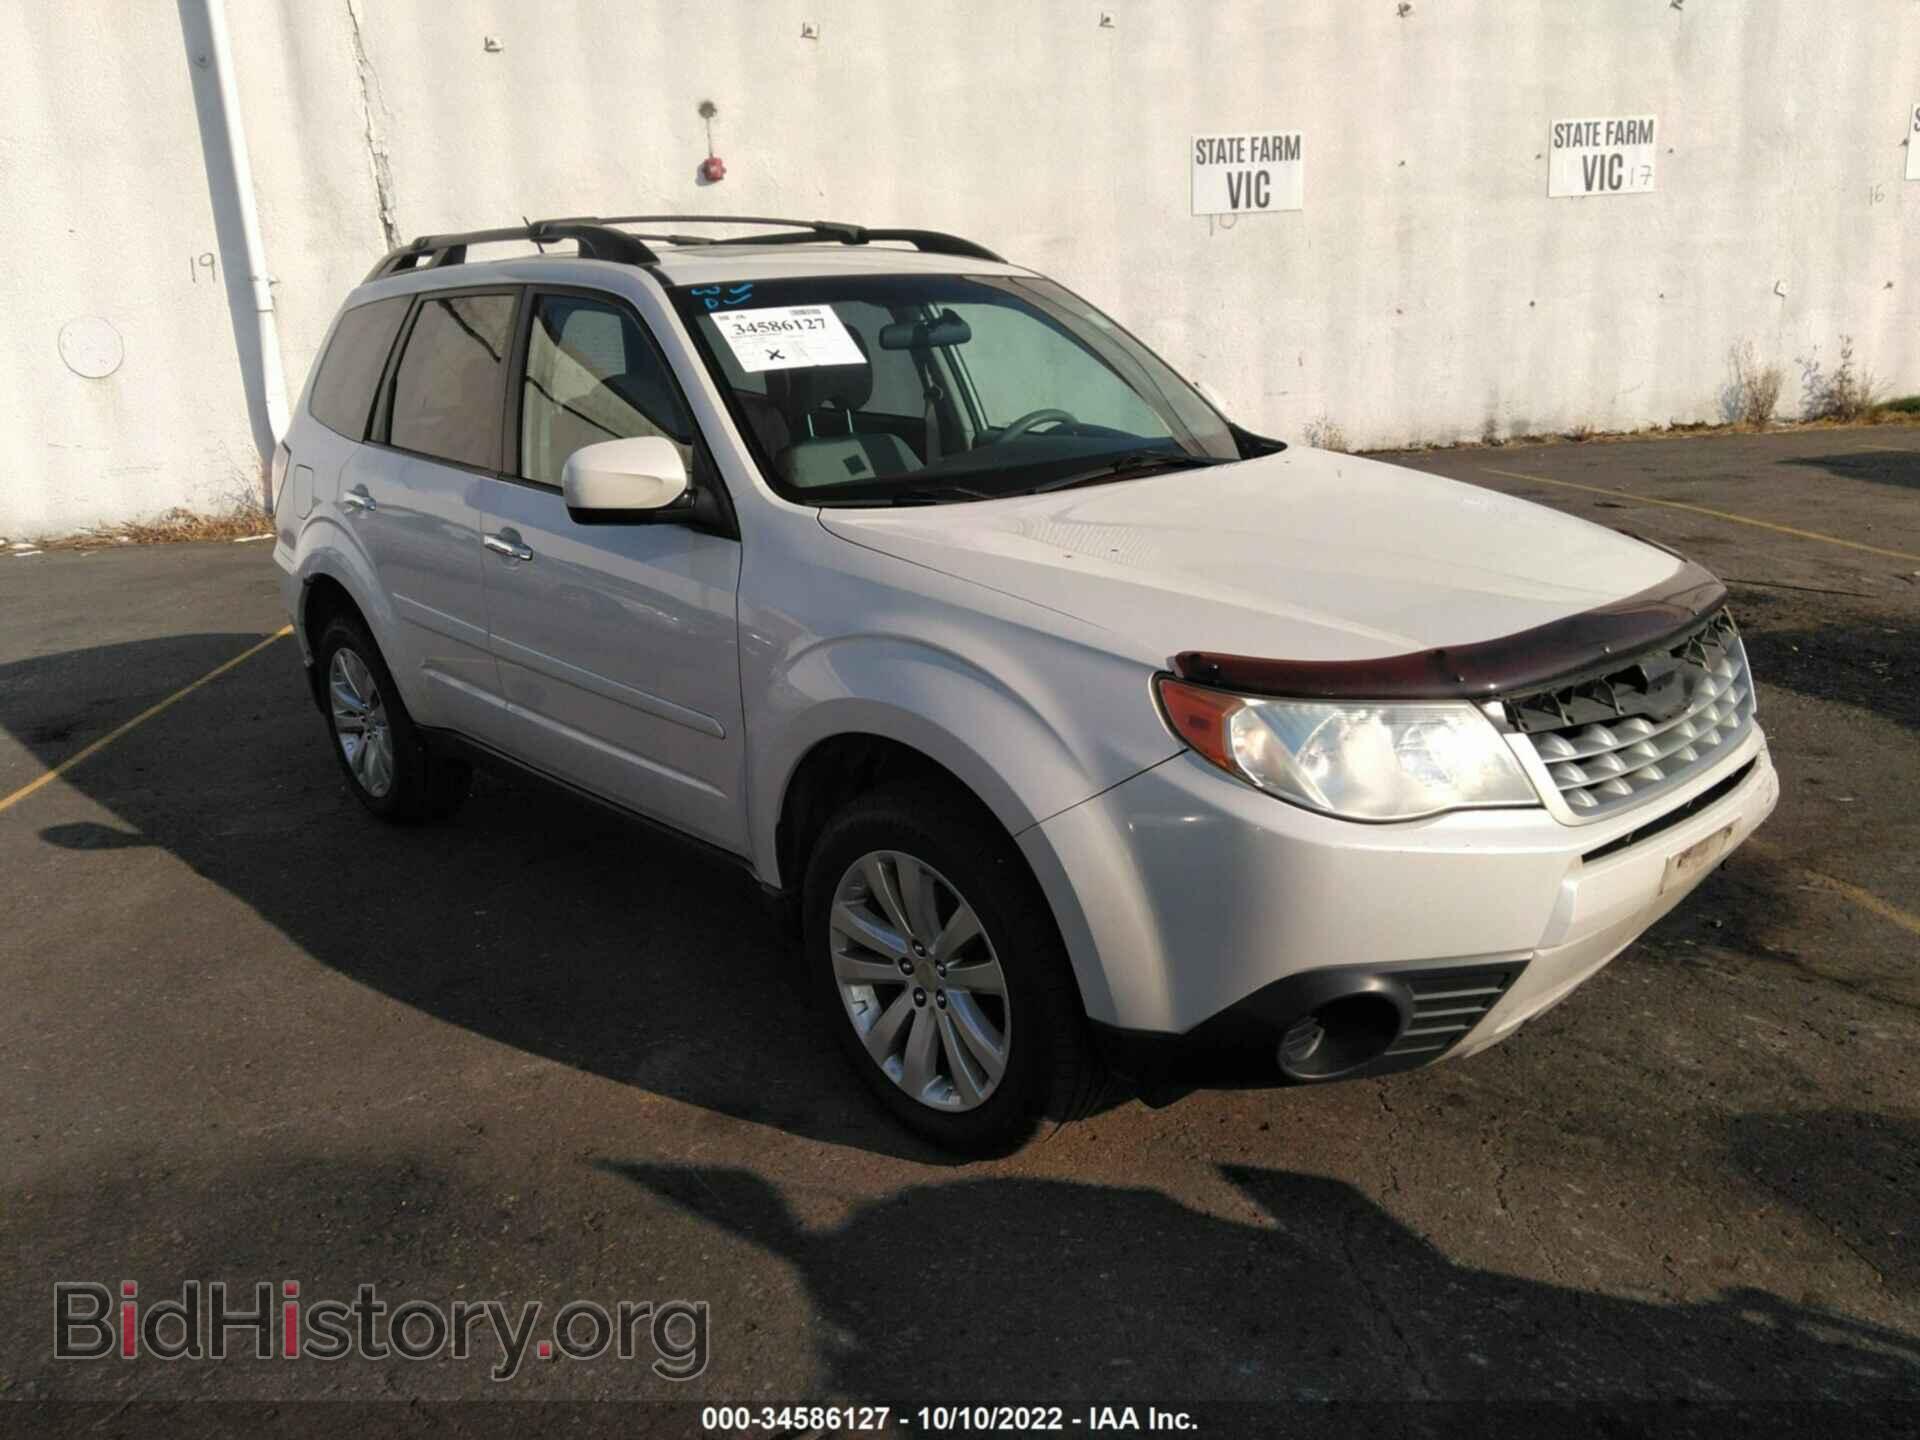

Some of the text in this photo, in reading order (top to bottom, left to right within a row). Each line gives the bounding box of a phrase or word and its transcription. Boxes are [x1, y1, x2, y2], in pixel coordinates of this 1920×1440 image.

[1195, 134, 1301, 165] STATE FARM
[1553, 119, 1654, 149] STATE FARM
[1582, 153, 1623, 192] VIC
[1630, 164, 1653, 186] 17
[1226, 169, 1271, 210] VIC
[189, 252, 216, 284] 19
[732, 318, 826, 336] 34586127
